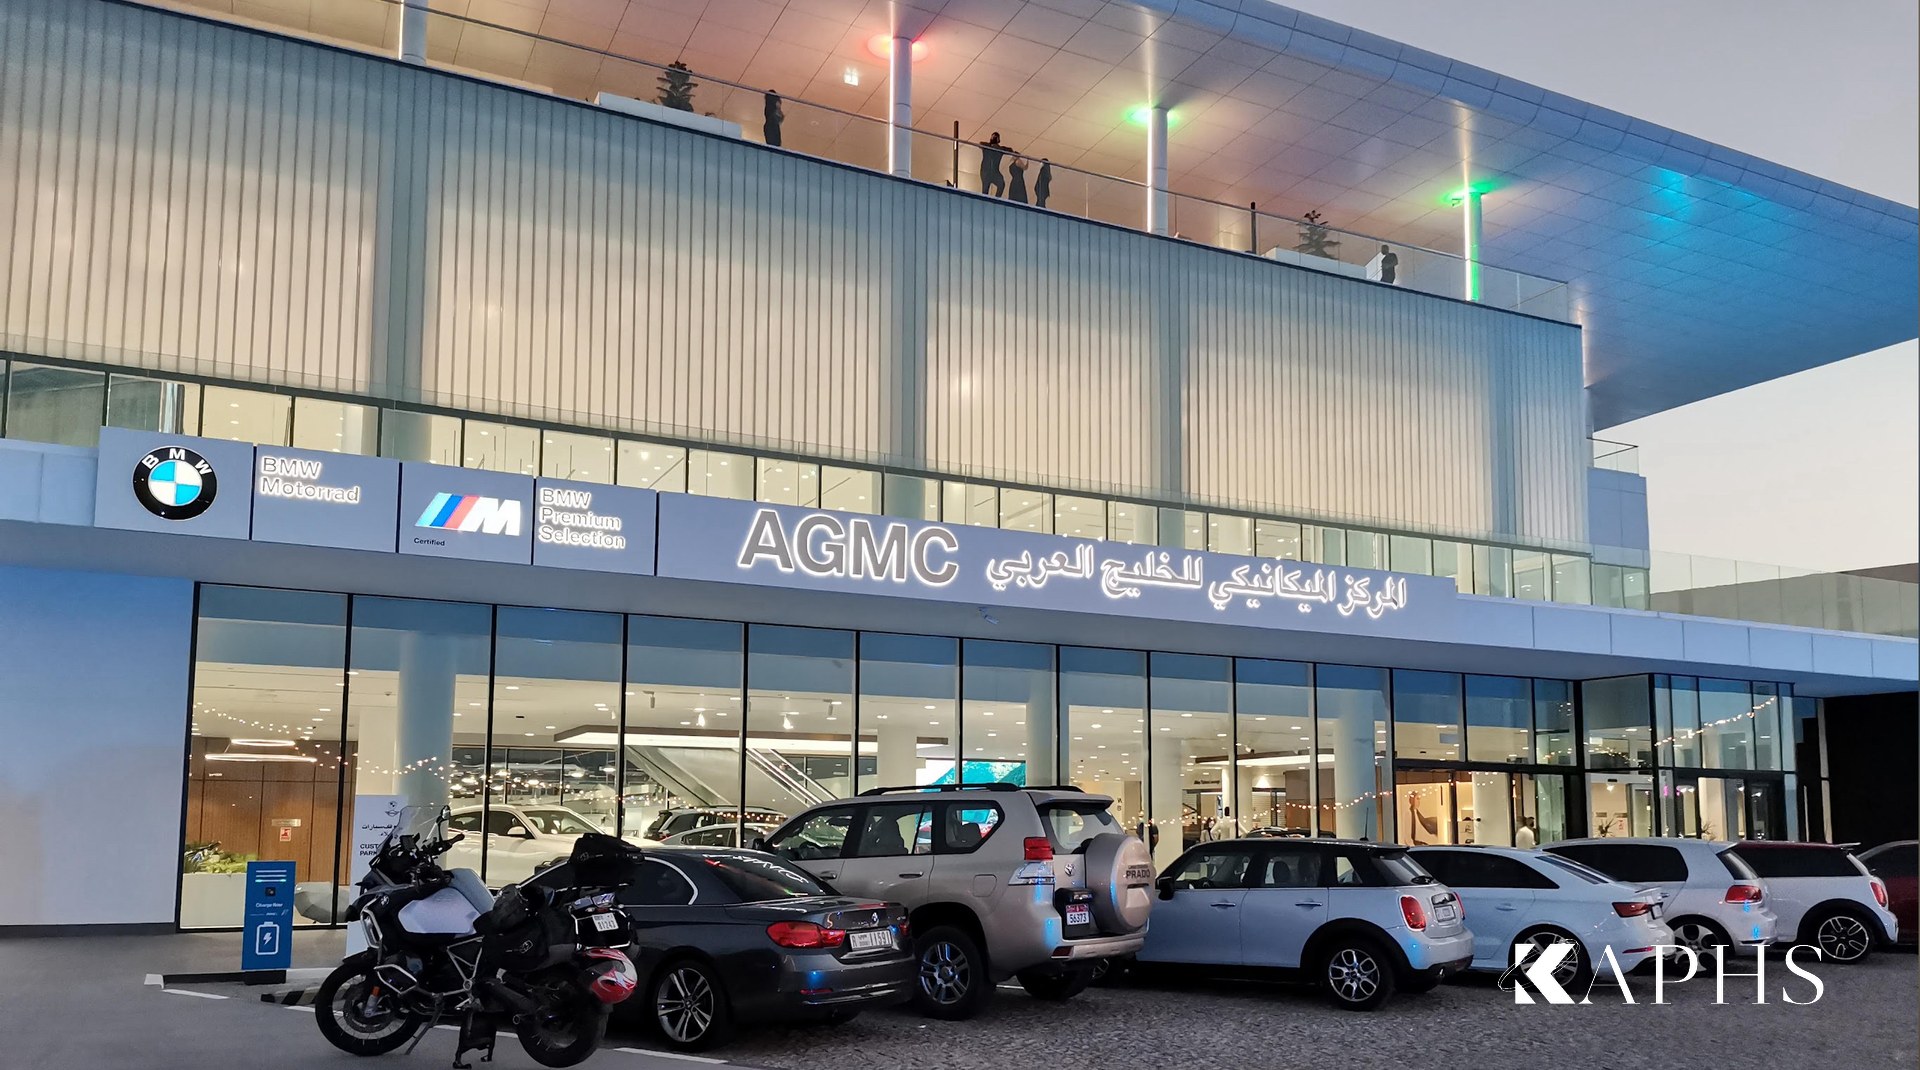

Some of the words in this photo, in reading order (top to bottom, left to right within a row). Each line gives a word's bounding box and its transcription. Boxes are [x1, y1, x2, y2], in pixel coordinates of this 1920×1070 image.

[141, 448, 213, 476] BMW
[261, 455, 322, 479] BMW
[261, 476, 360, 504] Motorrad
[540, 487, 591, 509] BMW
[540, 505, 622, 531] Premium
[413, 537, 446, 547] Certified
[539, 524, 626, 550] Selection
[738, 509, 959, 586] AGMC
[985, 544, 1095, 591] العربي
[1100, 551, 1203, 599] للخليج
[1208, 563, 1337, 611] الميكانيكي
[1337, 575, 1407, 619] المركز
[1125, 868, 1151, 880] PRADO
[1069, 913, 1087, 924] 56373
